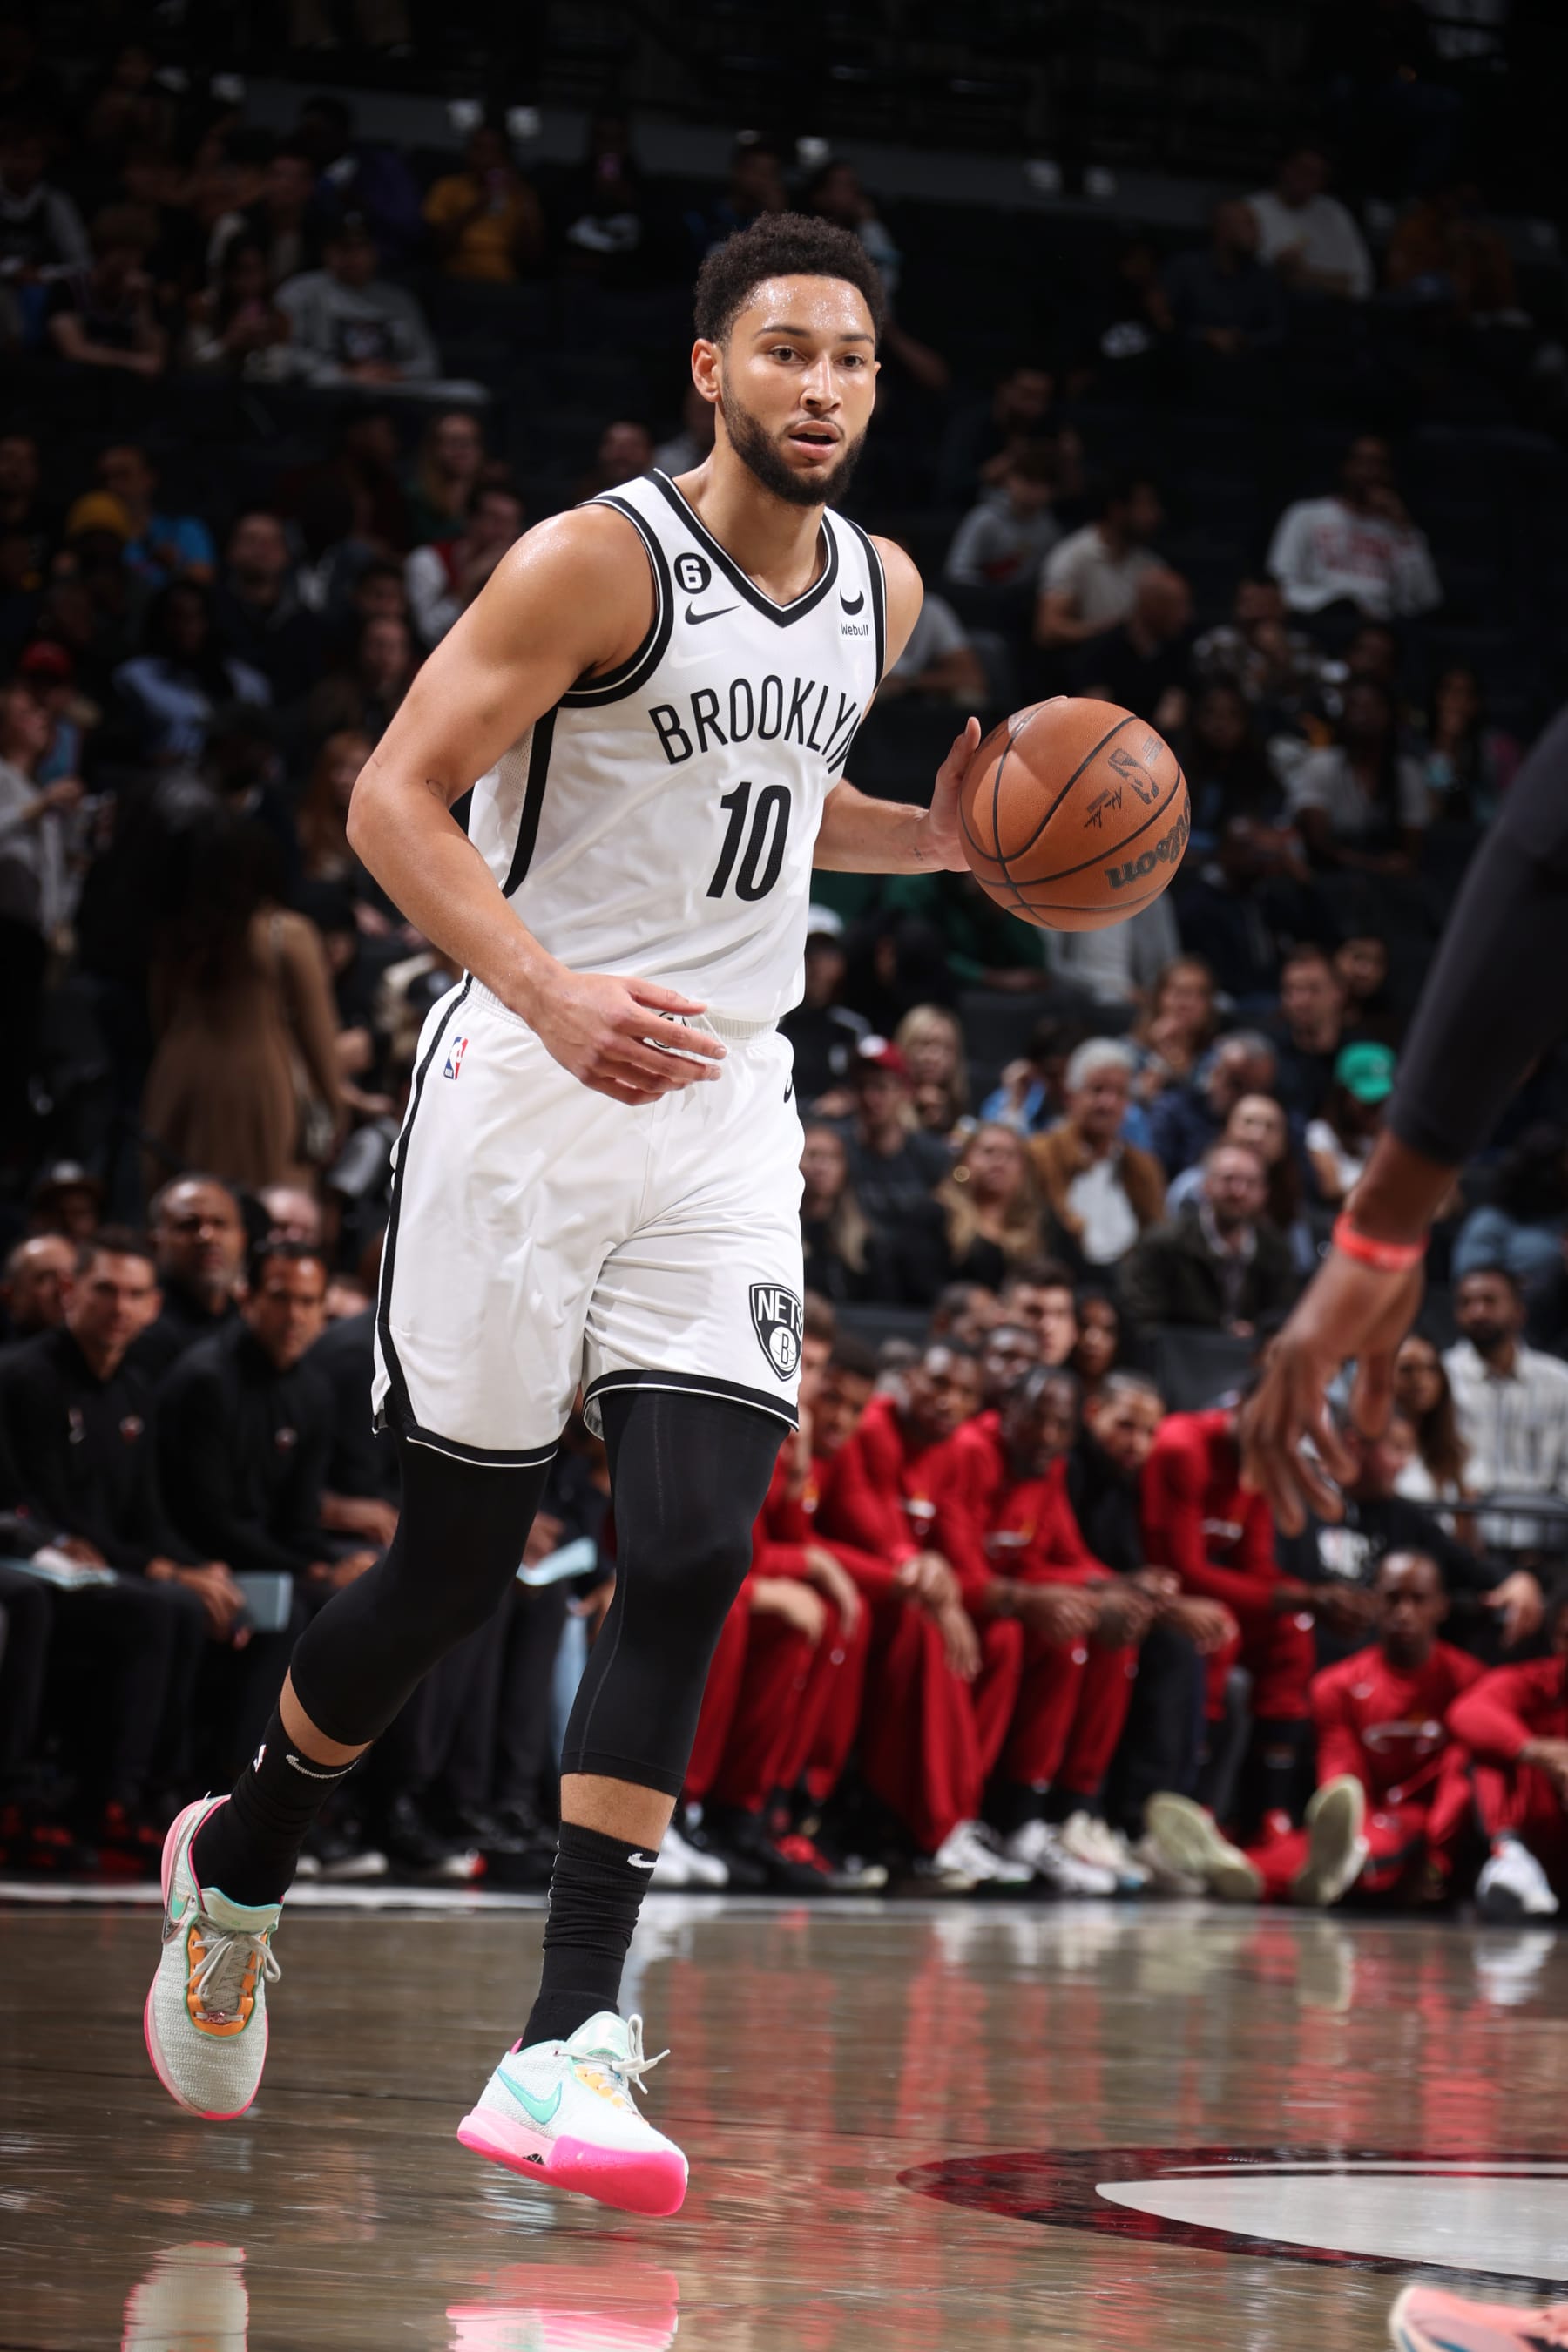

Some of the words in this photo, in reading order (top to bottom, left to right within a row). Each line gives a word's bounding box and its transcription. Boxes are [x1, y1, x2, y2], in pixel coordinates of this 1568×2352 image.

[680, 558, 703, 590] 6
[840, 622, 869, 637] Webull
[706, 781, 792, 901] 10
[781, 1332, 790, 1365] B
